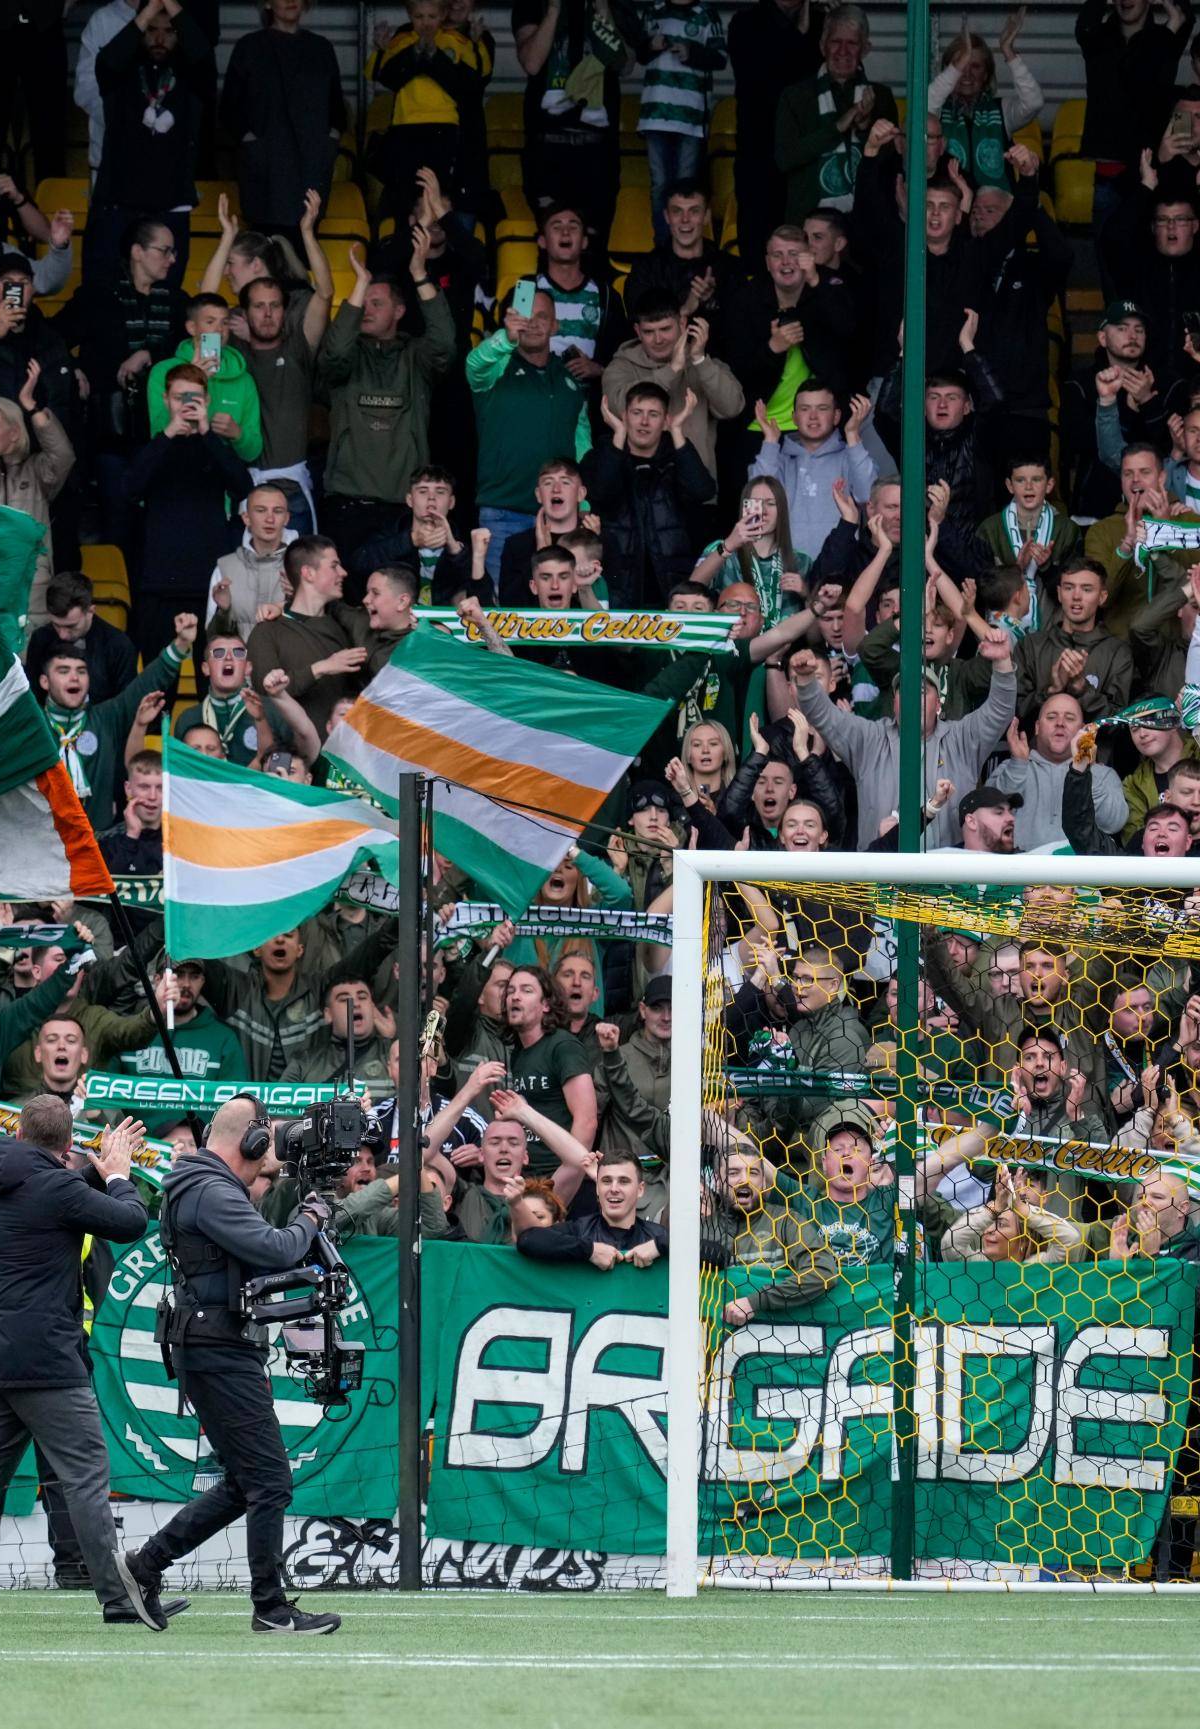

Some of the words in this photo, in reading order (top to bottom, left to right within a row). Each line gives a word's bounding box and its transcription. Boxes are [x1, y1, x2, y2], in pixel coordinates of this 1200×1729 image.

[580, 611, 684, 643] Celtic
[86, 1075, 204, 1103] GREEN
[1053, 1139, 1163, 1179] Celtic
[107, 1232, 168, 1301] GRE
[443, 1305, 1172, 1489] BRGADE
